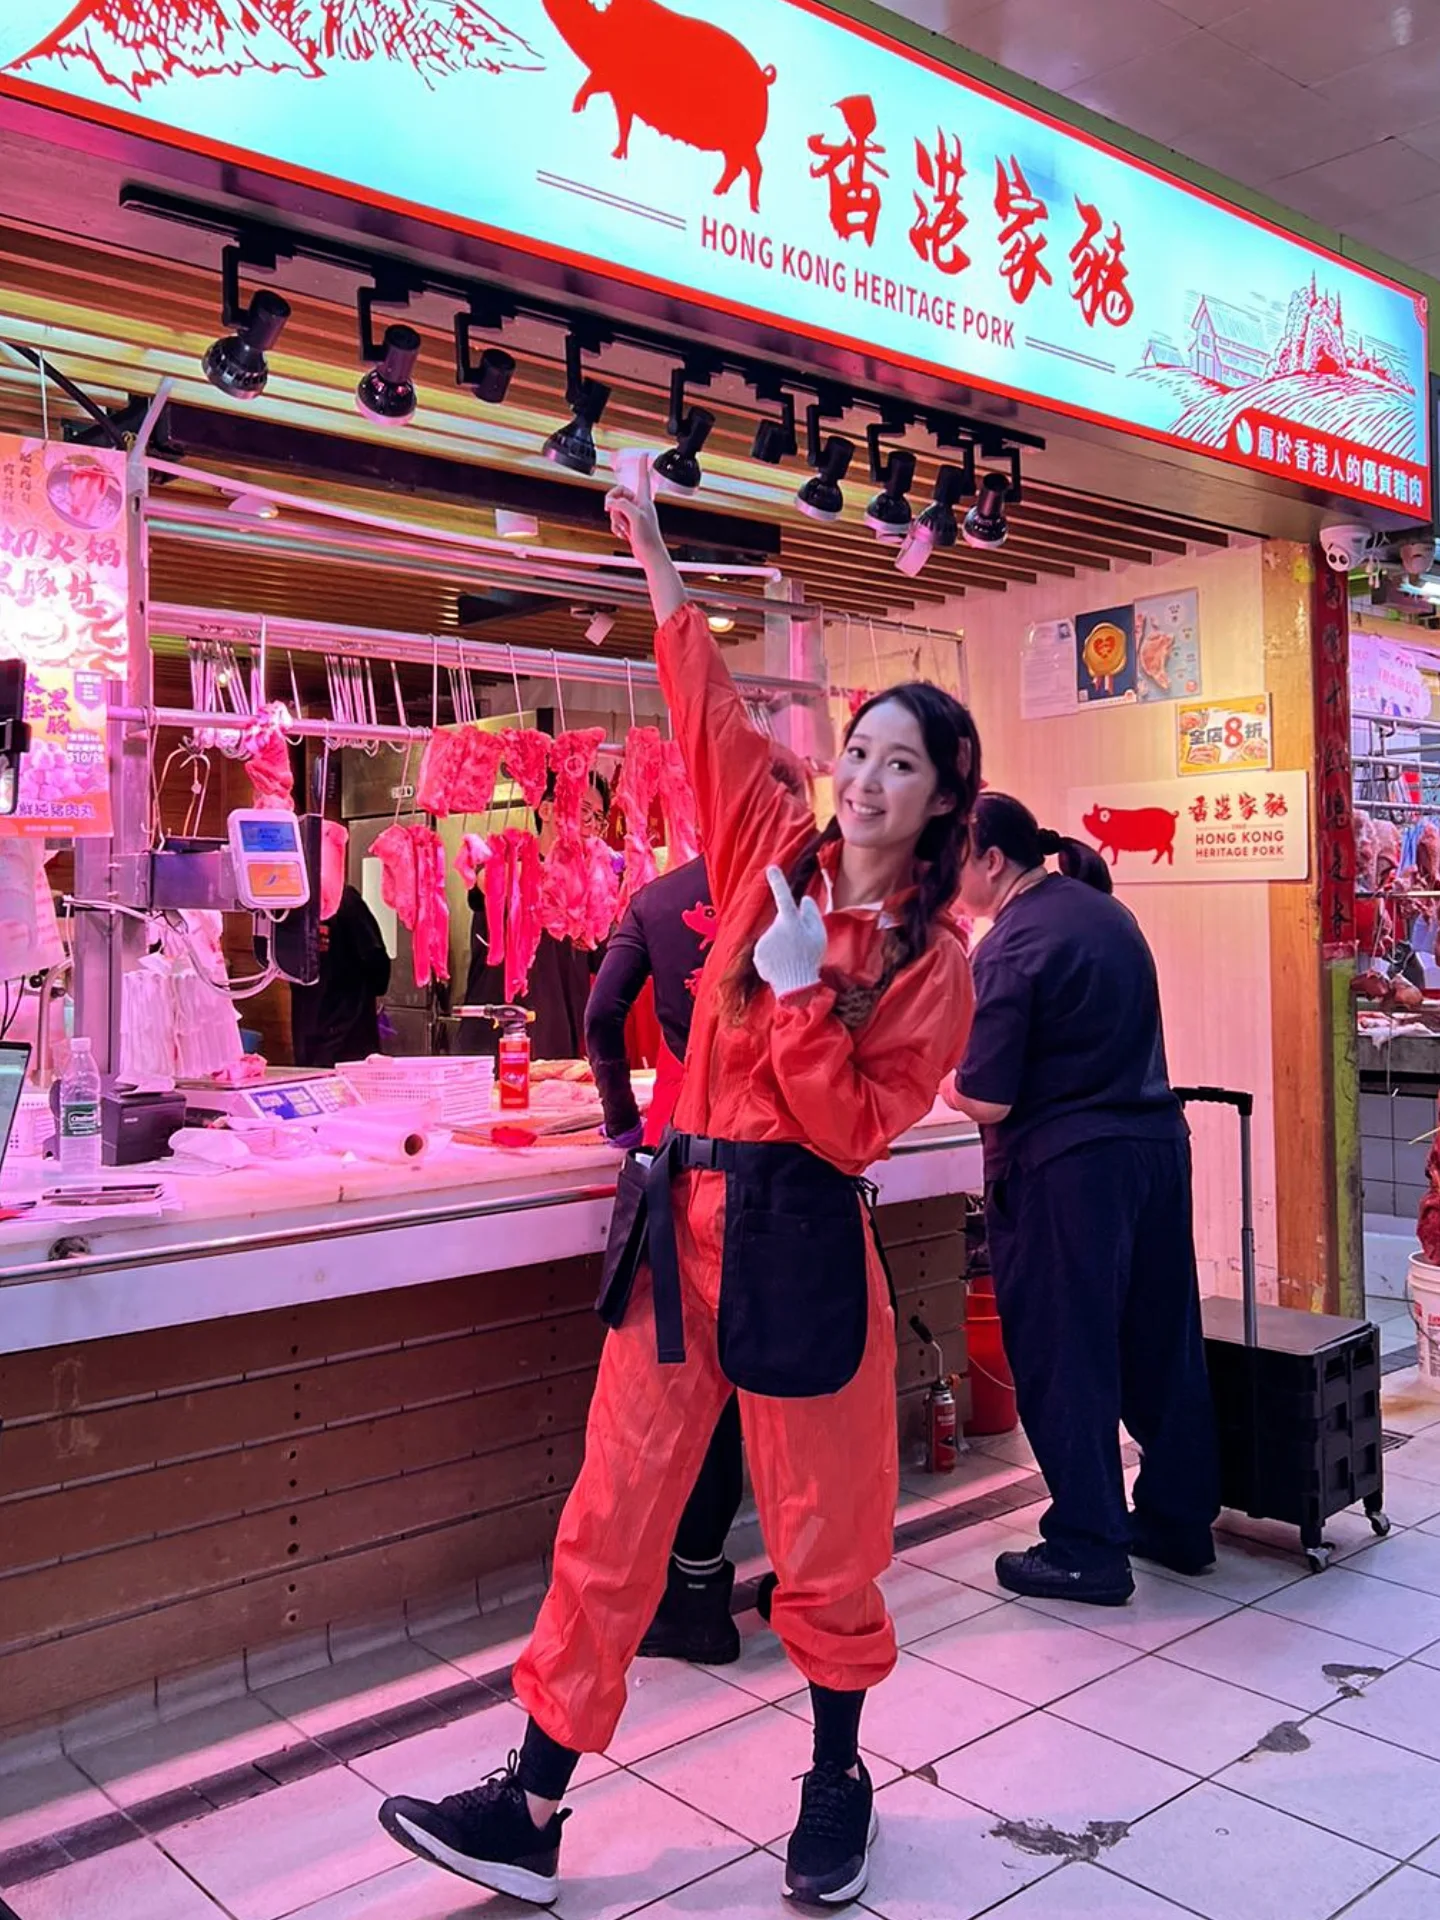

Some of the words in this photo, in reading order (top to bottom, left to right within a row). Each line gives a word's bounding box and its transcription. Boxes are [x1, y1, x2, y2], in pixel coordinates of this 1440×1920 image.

[807, 94, 1134, 328] 香港家豬
[700, 214, 774, 268] HONG
[782, 245, 847, 293] KONG
[854, 267, 956, 331] HERITAGE
[963, 306, 1016, 350] PORK
[1257, 425, 1423, 508] 屬於香港人的優質豬肉
[1188, 716, 1264, 749] 全店8折
[1196, 832, 1236, 845] HONG
[1242, 830, 1284, 843] KONG
[1196, 846, 1248, 858] HERITAGE
[1252, 845, 1284, 855] PORK
